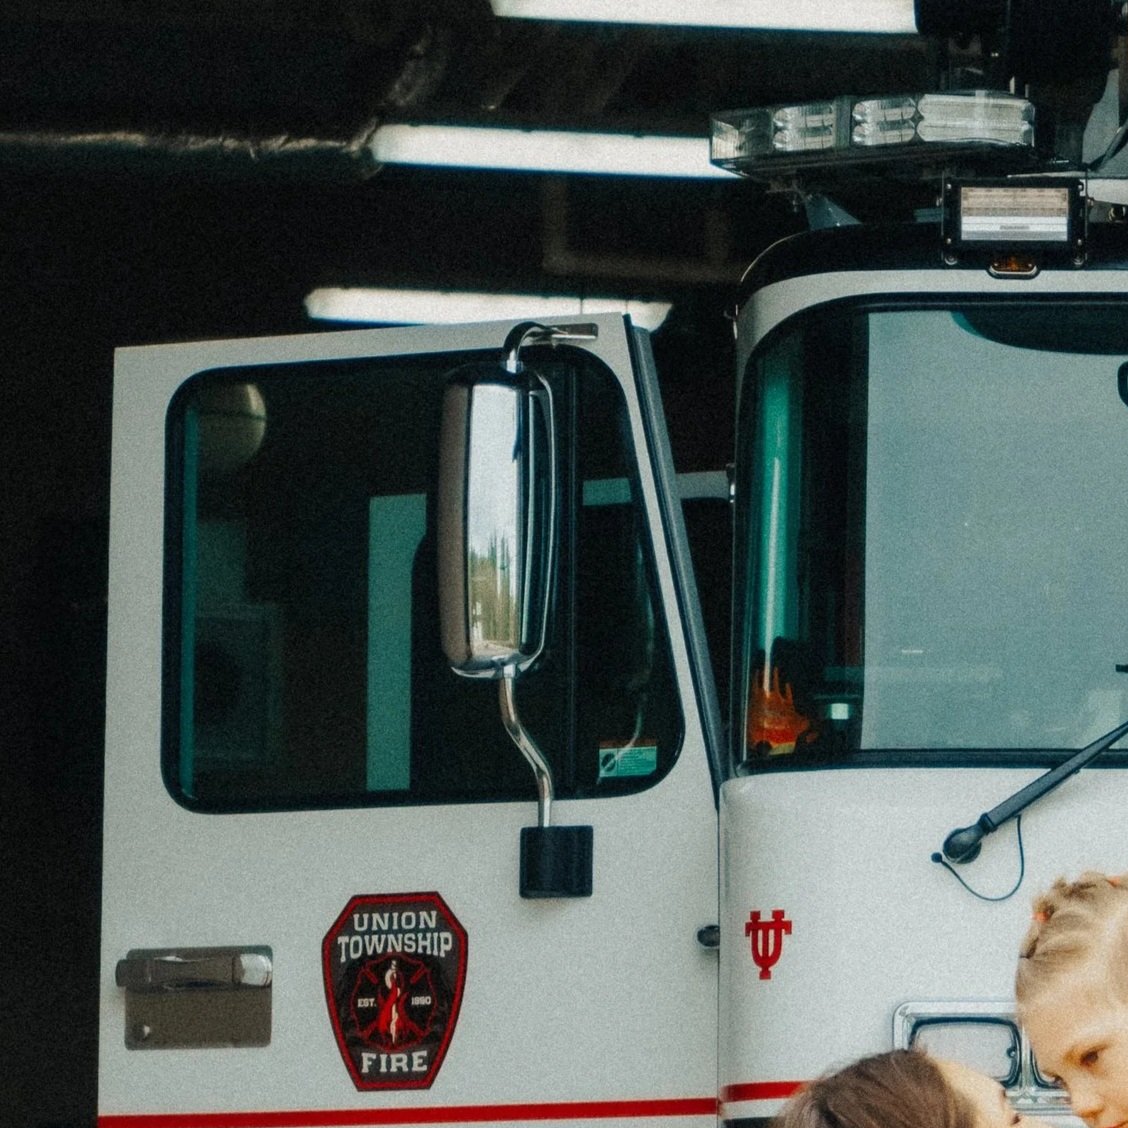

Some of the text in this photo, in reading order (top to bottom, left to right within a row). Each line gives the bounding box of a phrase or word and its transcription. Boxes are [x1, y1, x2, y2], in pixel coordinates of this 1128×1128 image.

[353, 910, 438, 932] UNION
[337, 931, 453, 963] TOWNSHIP
[357, 997, 377, 1008] EST.
[361, 1050, 429, 1073] FIRE
